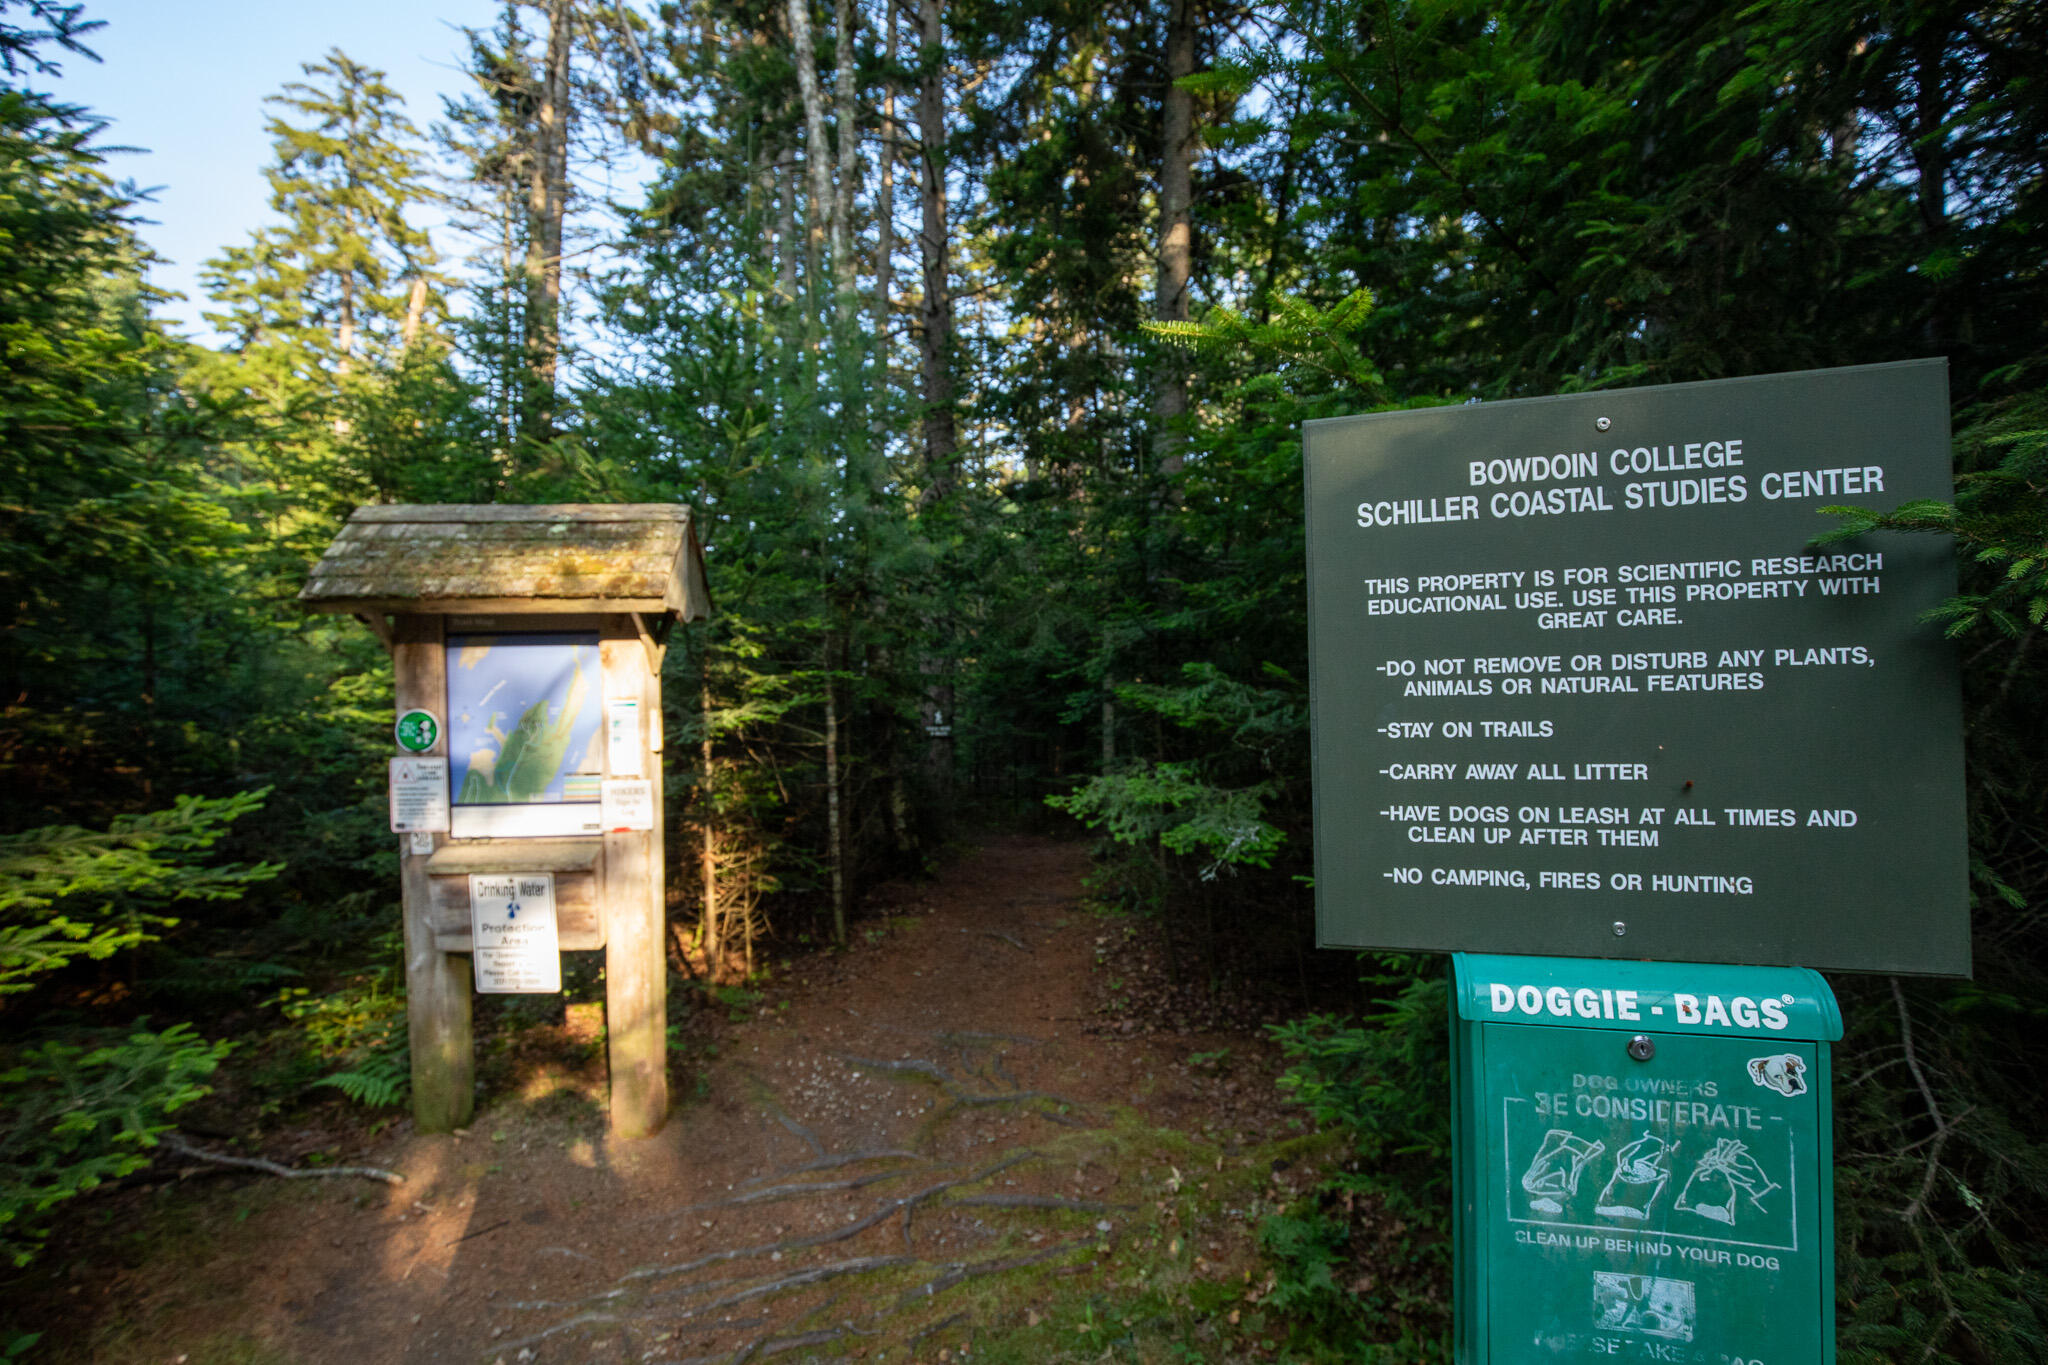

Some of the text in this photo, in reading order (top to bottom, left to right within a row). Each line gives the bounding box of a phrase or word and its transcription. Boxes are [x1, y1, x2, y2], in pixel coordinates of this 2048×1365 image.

[1469, 440, 1743, 486] BOWDOIN COLLEGE
[1357, 466, 1884, 527] SCHILLER COASTAL STUDIES CENTER
[1365, 553, 1882, 595] THIS PROPERTY IS FOR SCIENTIFIC RESEARCH
[1368, 577, 1879, 615] EDUCATIONAL USE. USE THIS PROPERTY WITH
[1538, 608, 1682, 629] GREAT CARE.
[1377, 647, 1874, 676] -DO NOT REMOVE OR DISTURB ANY PLANTS,
[1404, 672, 1764, 696] ANIMALS OR NATURAL FEATURES
[1377, 720, 1553, 738] -STAY ON TRAILS
[1379, 764, 1648, 780] -CARRY AWAY ALL LITTER
[1380, 805, 1857, 827] -HAVE DOGS ON LEASH AT ALL TIMES AND
[1408, 826, 1659, 846] CLEAN UP AFTER THEM
[477, 881, 545, 900] Drinking Water
[1383, 868, 1753, 895] -NO CAMPING, FIRES OR HUNTING
[1489, 982, 1641, 1021] DOGGIE
[1572, 1073, 1618, 1091] DOG
[1574, 1093, 1762, 1130] CONSIDERATE
[1514, 1230, 1780, 1271] CLEAN UP BEHIND YOUR DOG
